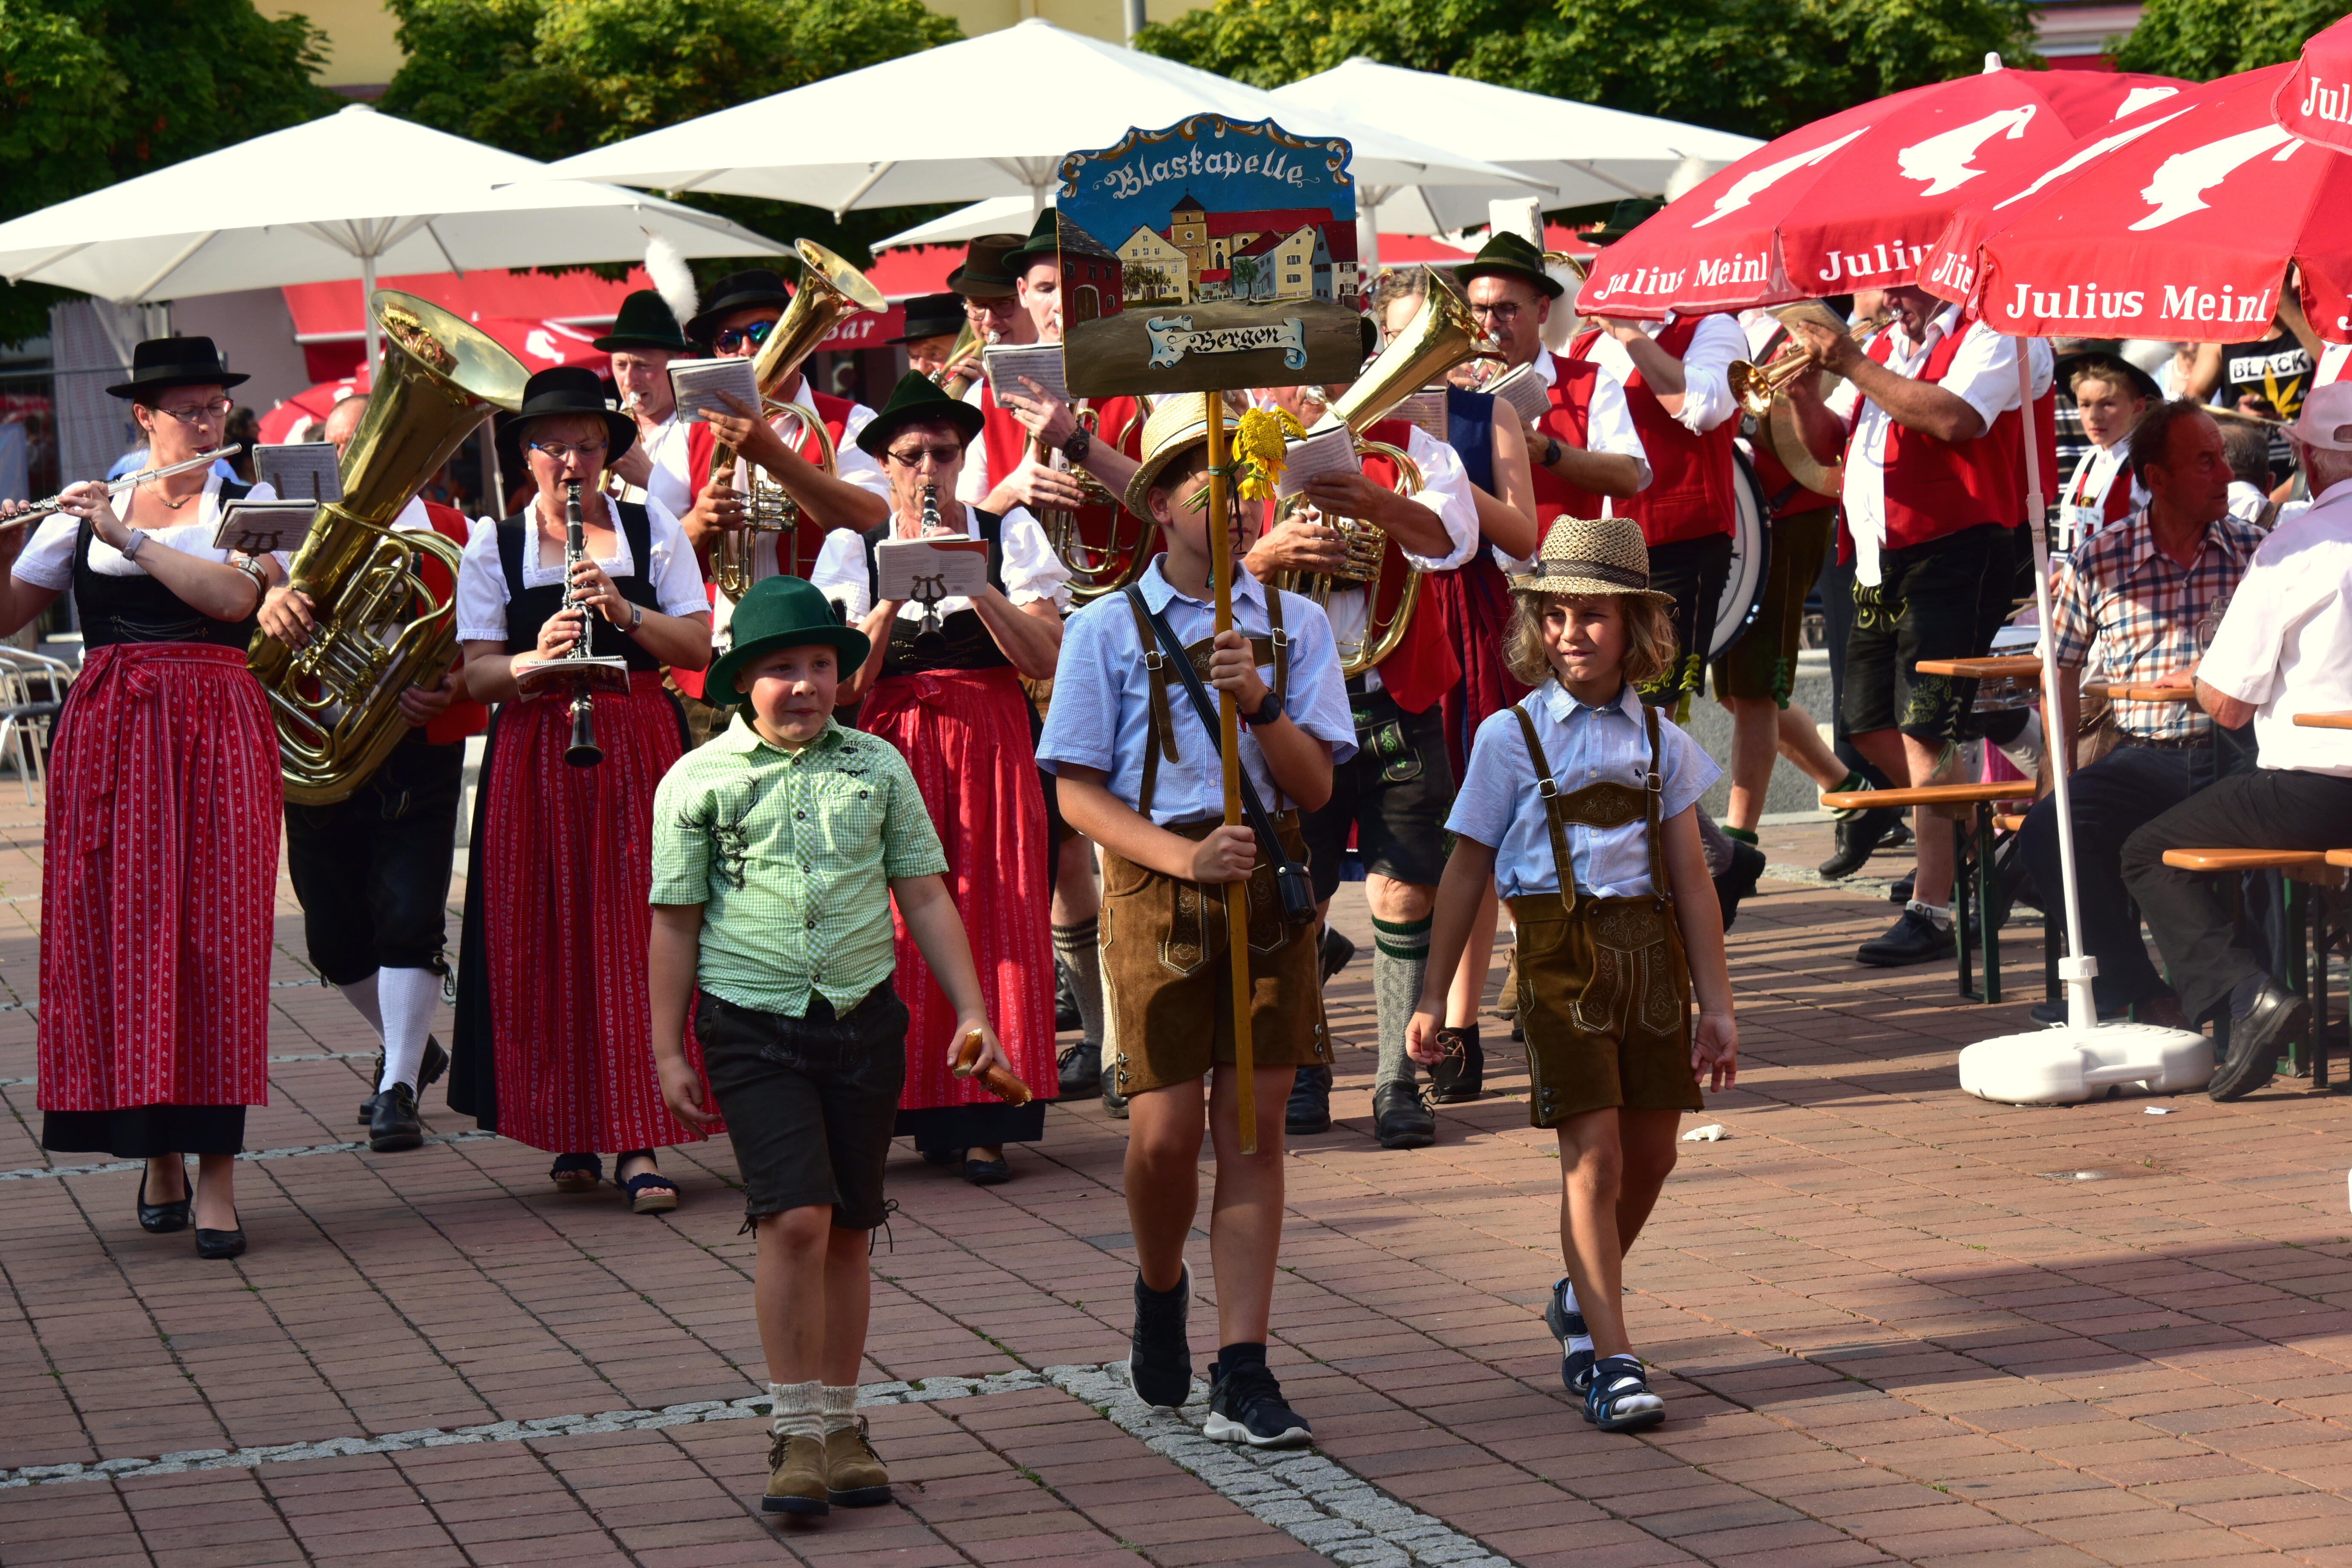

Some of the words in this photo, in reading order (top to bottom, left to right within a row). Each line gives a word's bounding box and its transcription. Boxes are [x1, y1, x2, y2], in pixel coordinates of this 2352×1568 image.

[1094, 142, 1318, 199] Blaskapelle
[1594, 267, 1686, 300] Julius
[1693, 252, 1767, 287] Meinl
[2006, 283, 2144, 319] Julius
[2160, 285, 2270, 322] Meinl
[1190, 326, 1280, 352] Bergen
[2234, 351, 2308, 378] BLACK
